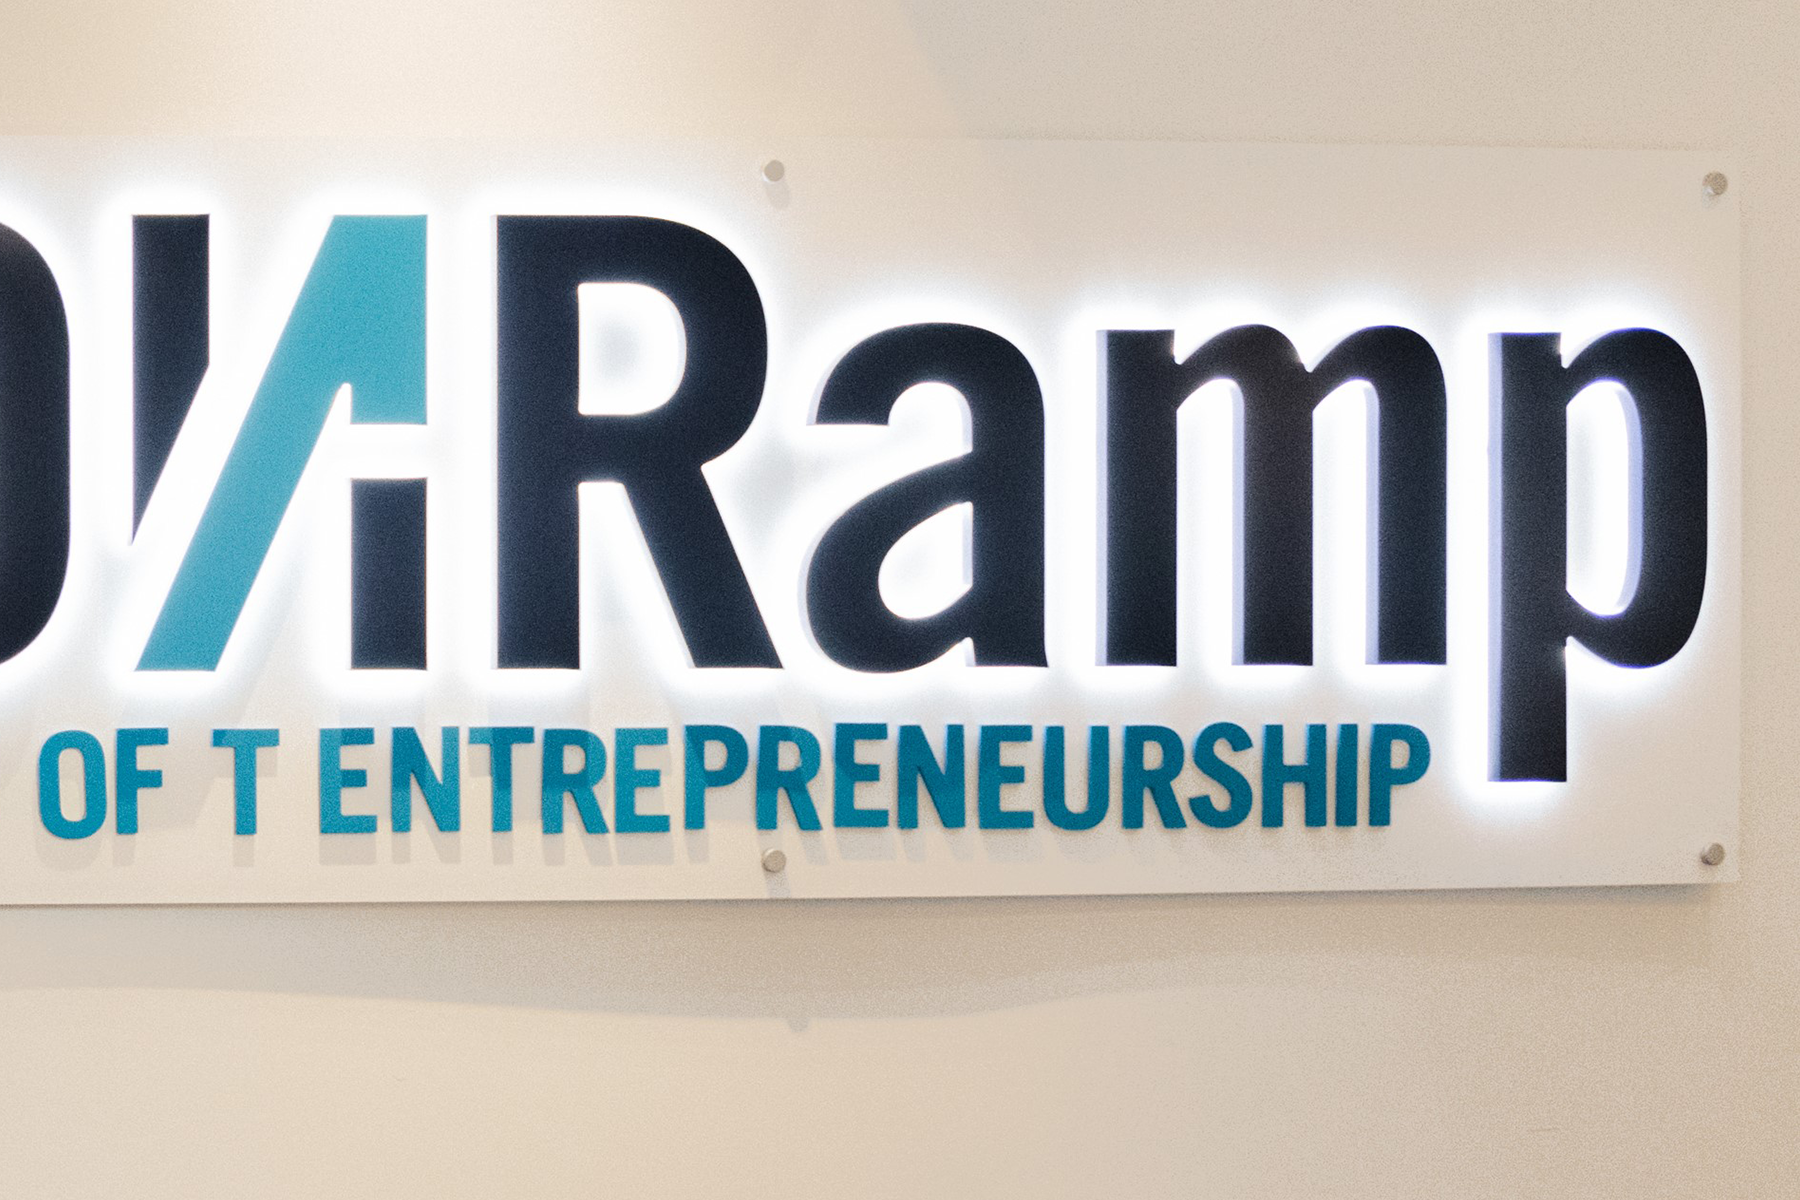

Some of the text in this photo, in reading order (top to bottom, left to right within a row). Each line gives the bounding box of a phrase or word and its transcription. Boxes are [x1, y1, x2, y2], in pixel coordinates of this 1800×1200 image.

[37, 727, 169, 840] OF
[211, 728, 280, 836] T
[318, 721, 1432, 834] ENTREPRENEURSHIP
